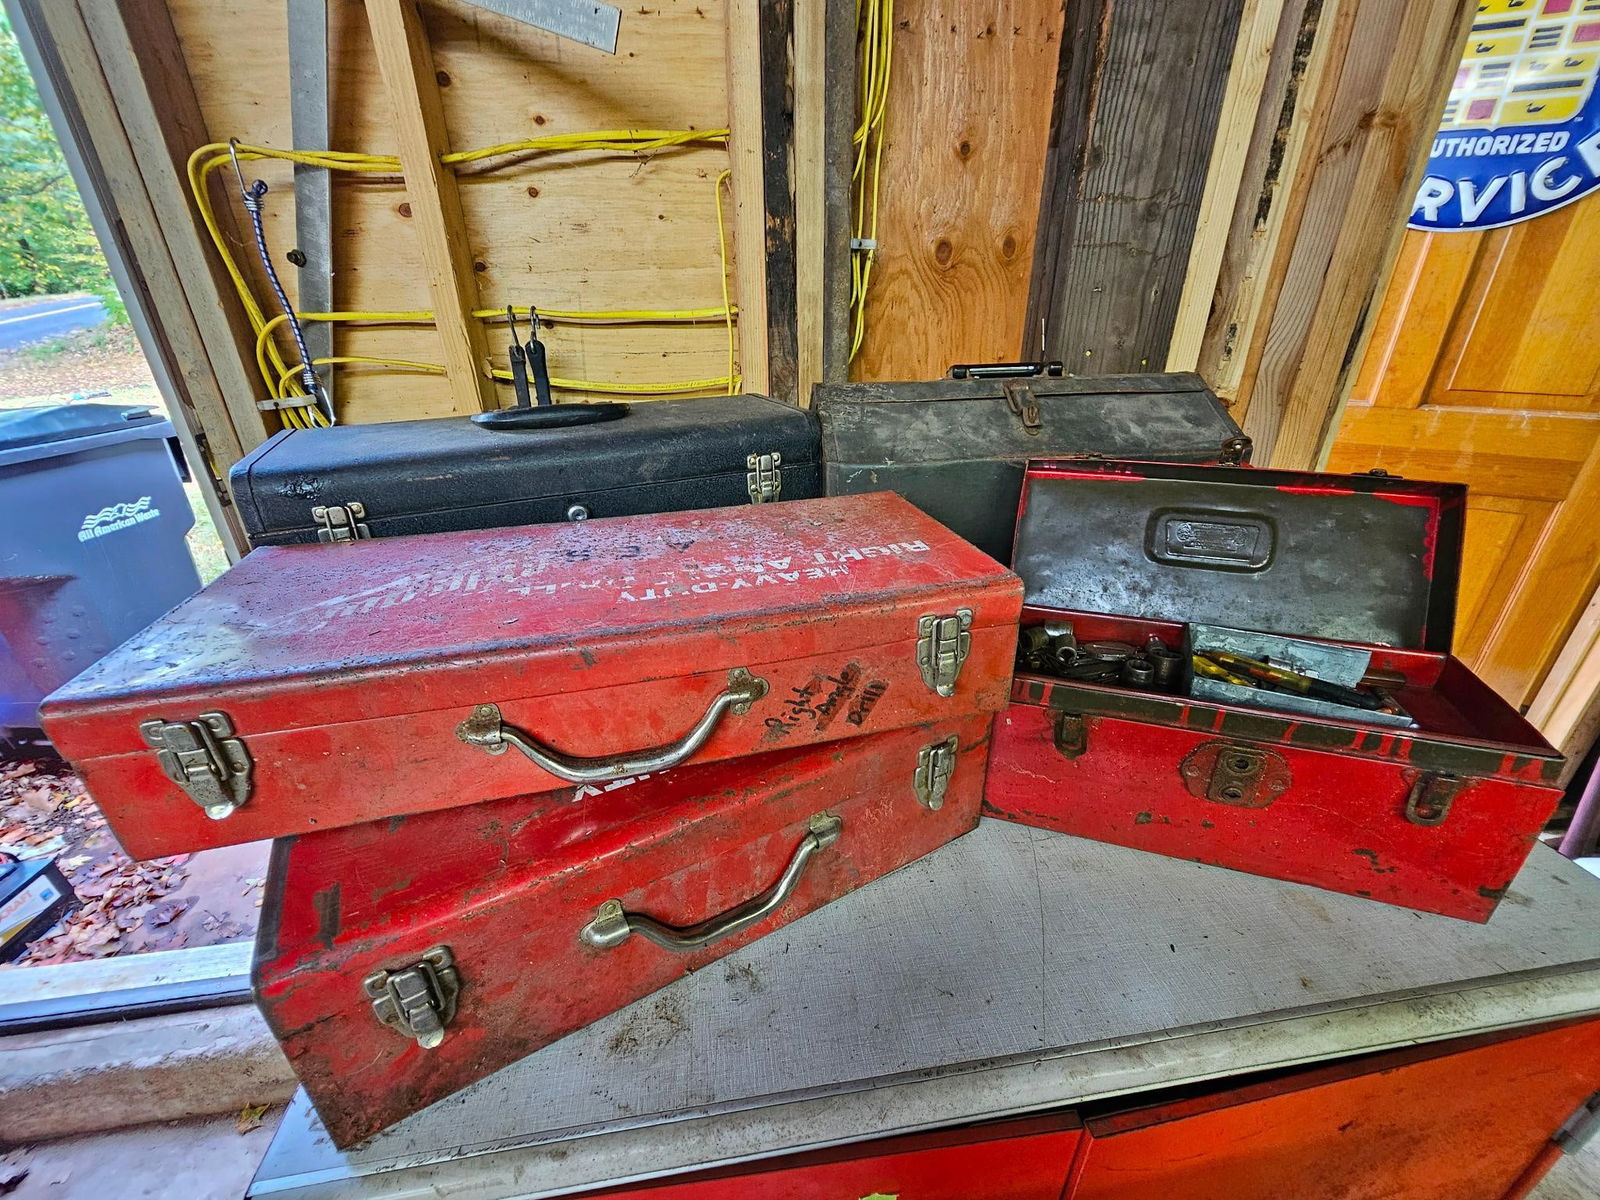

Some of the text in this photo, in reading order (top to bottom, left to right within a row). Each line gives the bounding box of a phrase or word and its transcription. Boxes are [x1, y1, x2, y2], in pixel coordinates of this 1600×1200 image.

[1430, 131, 1570, 158] UTHORIZED
[1411, 131, 1600, 222] RVIC
[78, 509, 160, 542] All American Waste
[812, 538, 931, 565] RIGHT
[765, 687, 816, 735] Right
